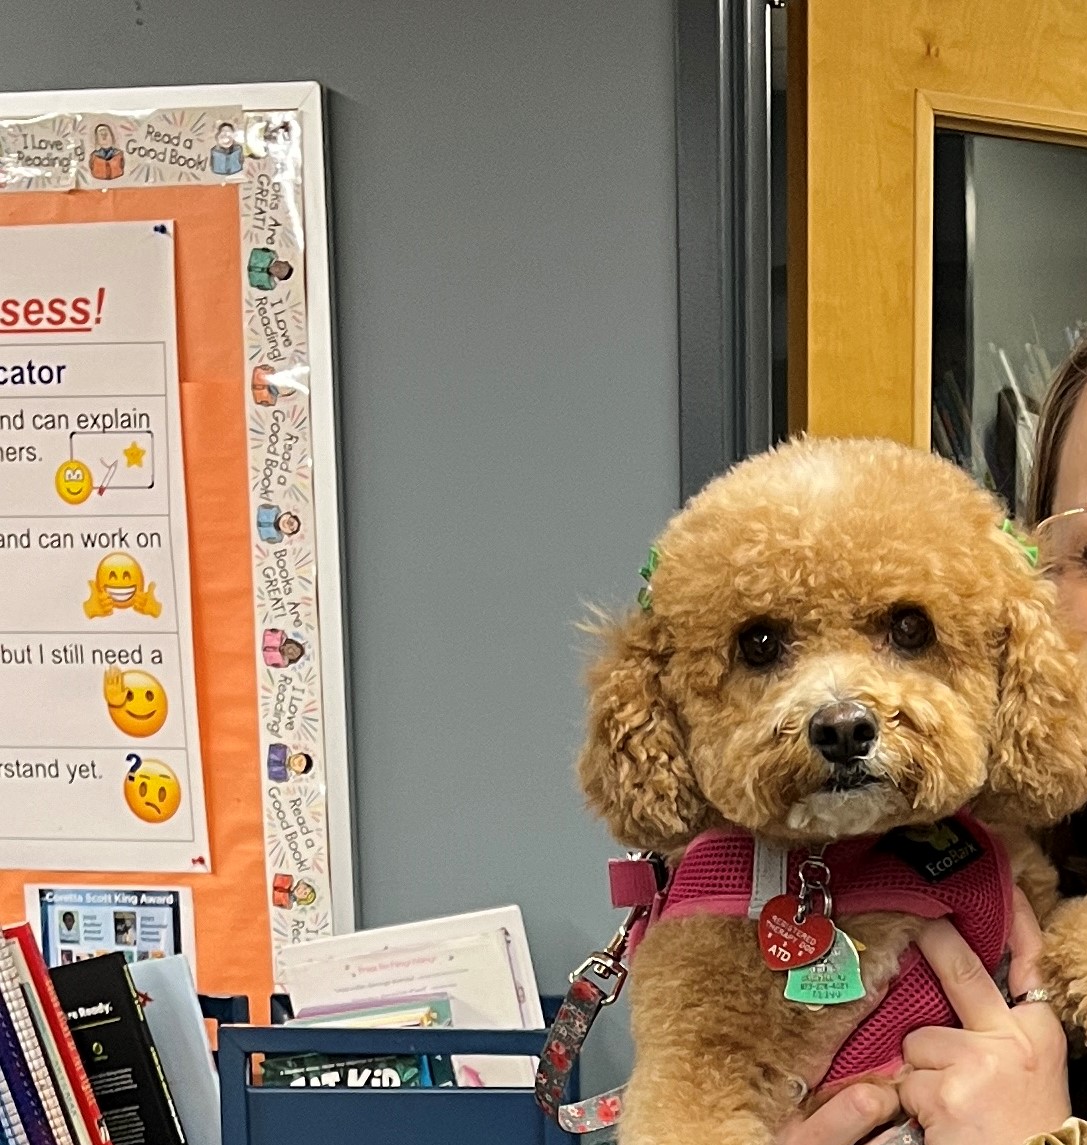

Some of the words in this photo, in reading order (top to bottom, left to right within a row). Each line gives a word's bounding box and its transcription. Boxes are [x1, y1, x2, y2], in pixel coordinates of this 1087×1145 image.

[22, 133, 28, 149] I
[31, 134, 63, 151] Love
[126, 139, 168, 163] Good
[145, 124, 182, 147] Read
[183, 138, 193, 149] a
[252, 174, 270, 230] GREAT!
[0, 287, 105, 326] sess!
[270, 298, 283, 308] I
[255, 296, 286, 362] Reading!
[274, 309, 292, 347] Love
[0, 359, 66, 385] cator
[32, 413, 69, 430] can
[77, 408, 150, 433] explain
[267, 410, 285, 456] Good
[280, 432, 299, 473] Read
[260, 458, 278, 501] Book!
[277, 475, 287, 486] a
[38, 532, 74, 548] can
[81, 527, 129, 548] work
[136, 532, 161, 548] on
[262, 566, 287, 618] GREAT!
[274, 549, 294, 595] Books
[287, 602, 302, 627] Are
[1, 644, 32, 664] but
[39, 643, 44, 664] I
[51, 643, 84, 664] still
[92, 644, 142, 664] need
[150, 648, 163, 665] a
[292, 686, 305, 694] I
[266, 674, 292, 738] Reading!
[285, 696, 302, 730] Love
[0, 759, 60, 778] stand
[67, 760, 103, 784] yet.
[268, 787, 294, 830] Good
[285, 831, 310, 872] Book!
[289, 797, 314, 835] Read
[305, 838, 315, 849] a
[925, 841, 977, 877] EcoBark
[85, 893, 113, 904] Scott
[114, 893, 138, 905] King
[140, 894, 174, 905] Award
[766, 919, 798, 944] THERAPY
[768, 944, 791, 962] ATD
